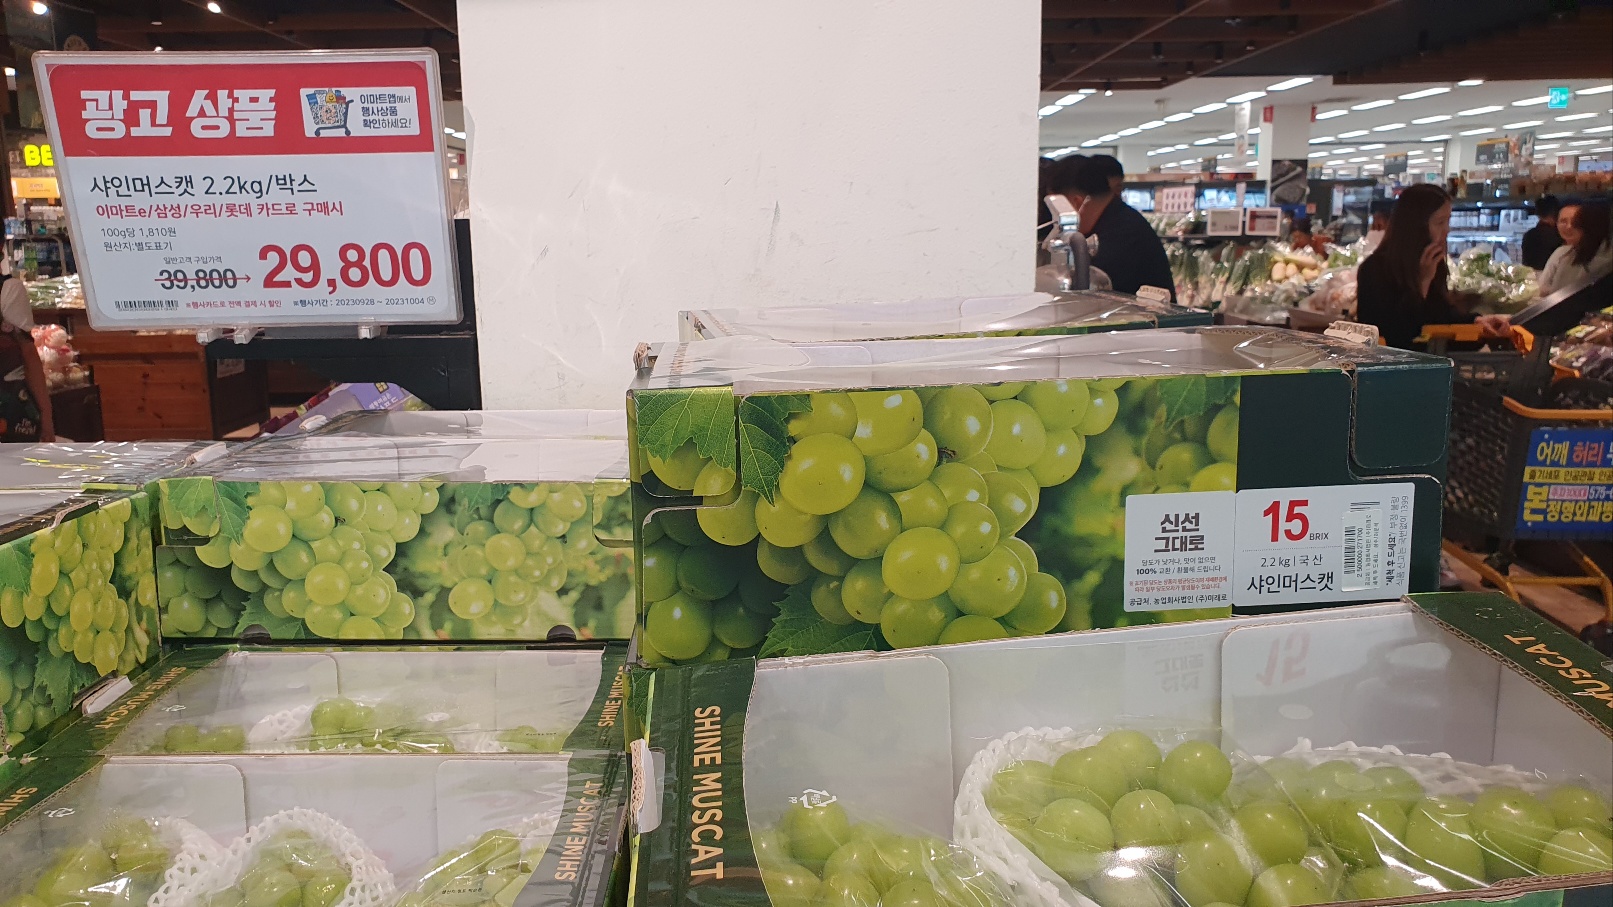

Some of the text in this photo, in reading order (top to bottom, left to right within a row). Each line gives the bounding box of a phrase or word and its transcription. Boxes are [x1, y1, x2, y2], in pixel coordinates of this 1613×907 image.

[360, 93, 411, 104] 이마트앱에서
[80, 89, 276, 139] 광고 상품
[361, 105, 398, 117] 행사상품
[362, 117, 412, 129] 확인하세요!
[90, 173, 318, 199] 샤인머스캣 2.2kg/박스
[96, 200, 345, 219] 이마트e/삼성/우리/롯데 카드로 구매시
[100, 226, 177, 240] 100g당 1,810원
[103, 240, 173, 252] 원산지:별도표기
[163, 256, 222, 265] 일반고객 구입가격
[258, 241, 432, 295] 29,800
[159, 268, 238, 292] 39,800
[228, 300, 242, 308] 전액
[244, 300, 258, 308] 결제
[259, 300, 267, 308] 시
[268, 299, 282, 308] 할인
[335, 298, 375, 307] 20230928
[385, 297, 425, 306] 20231004
[1537, 440, 1570, 466] 어깨
[1573, 440, 1604, 466] 허리
[1160, 512, 1200, 533] 신선
[1262, 499, 1330, 543] 15 BRIX
[1398, 515, 1408, 544] 국번없이
[1154, 534, 1205, 553] 그대로
[1196, 565, 1221, 573] 드립니다
[1398, 547, 1406, 570] 신고는
[1247, 571, 1334, 594] 샤인머스캣
[1396, 572, 1405, 586] 식품
[1154, 596, 1194, 605] 농업회사법인
[1196, 594, 1228, 603] (주)미래로
[95, 666, 187, 729] SHINE MUSCAT
[597, 700, 622, 727] SHINE
[691, 705, 724, 880] SHINE MUSCAT
[554, 780, 603, 881] SHINE MUSCAT
